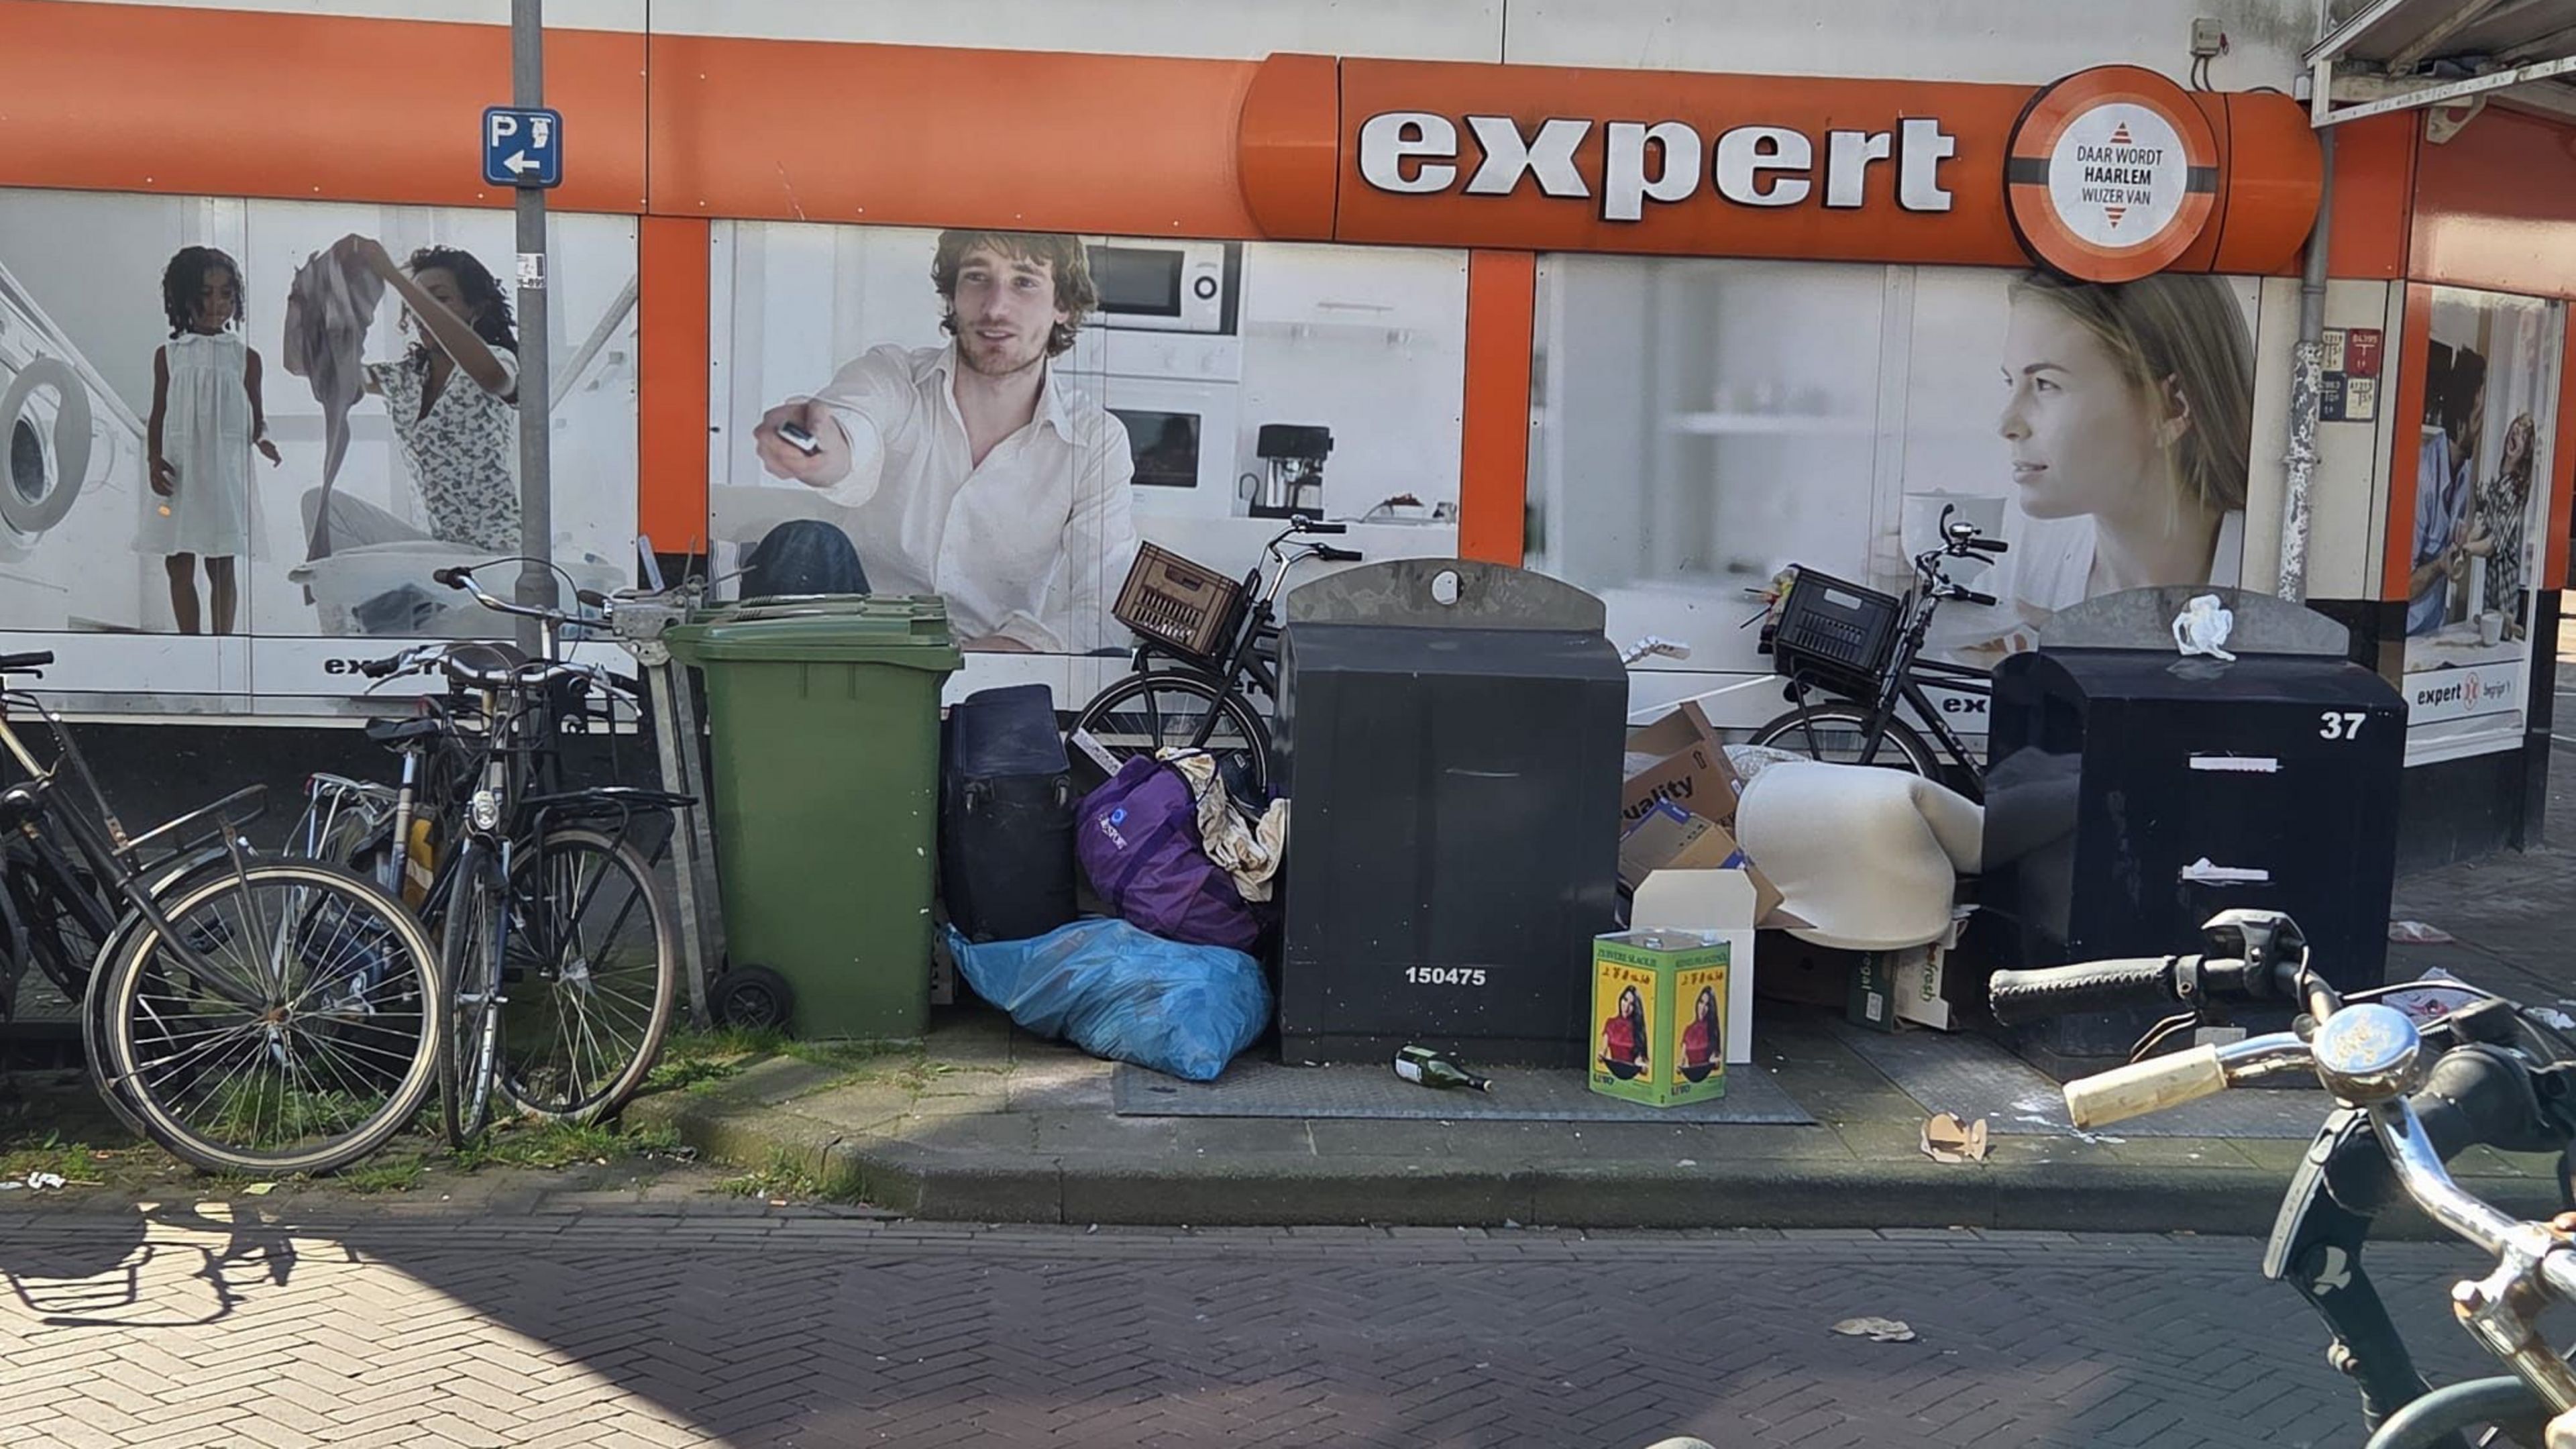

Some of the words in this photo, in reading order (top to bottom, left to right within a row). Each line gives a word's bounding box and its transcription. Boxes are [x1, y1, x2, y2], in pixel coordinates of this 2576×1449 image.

[492, 115, 517, 147] P
[1359, 111, 1955, 220] expert
[2077, 145, 2112, 163] DAAR
[2116, 147, 2163, 166] WORDT
[2084, 166, 2151, 185] HAARLEM
[2082, 187, 2124, 204] WIJZER
[2127, 189, 2151, 205] VAN
[2417, 682, 2461, 706] expert
[2320, 711, 2366, 740] 37
[1621, 776, 1693, 820] uality
[1405, 966, 1486, 985] 150475
[1919, 963, 1938, 1003] fresh
